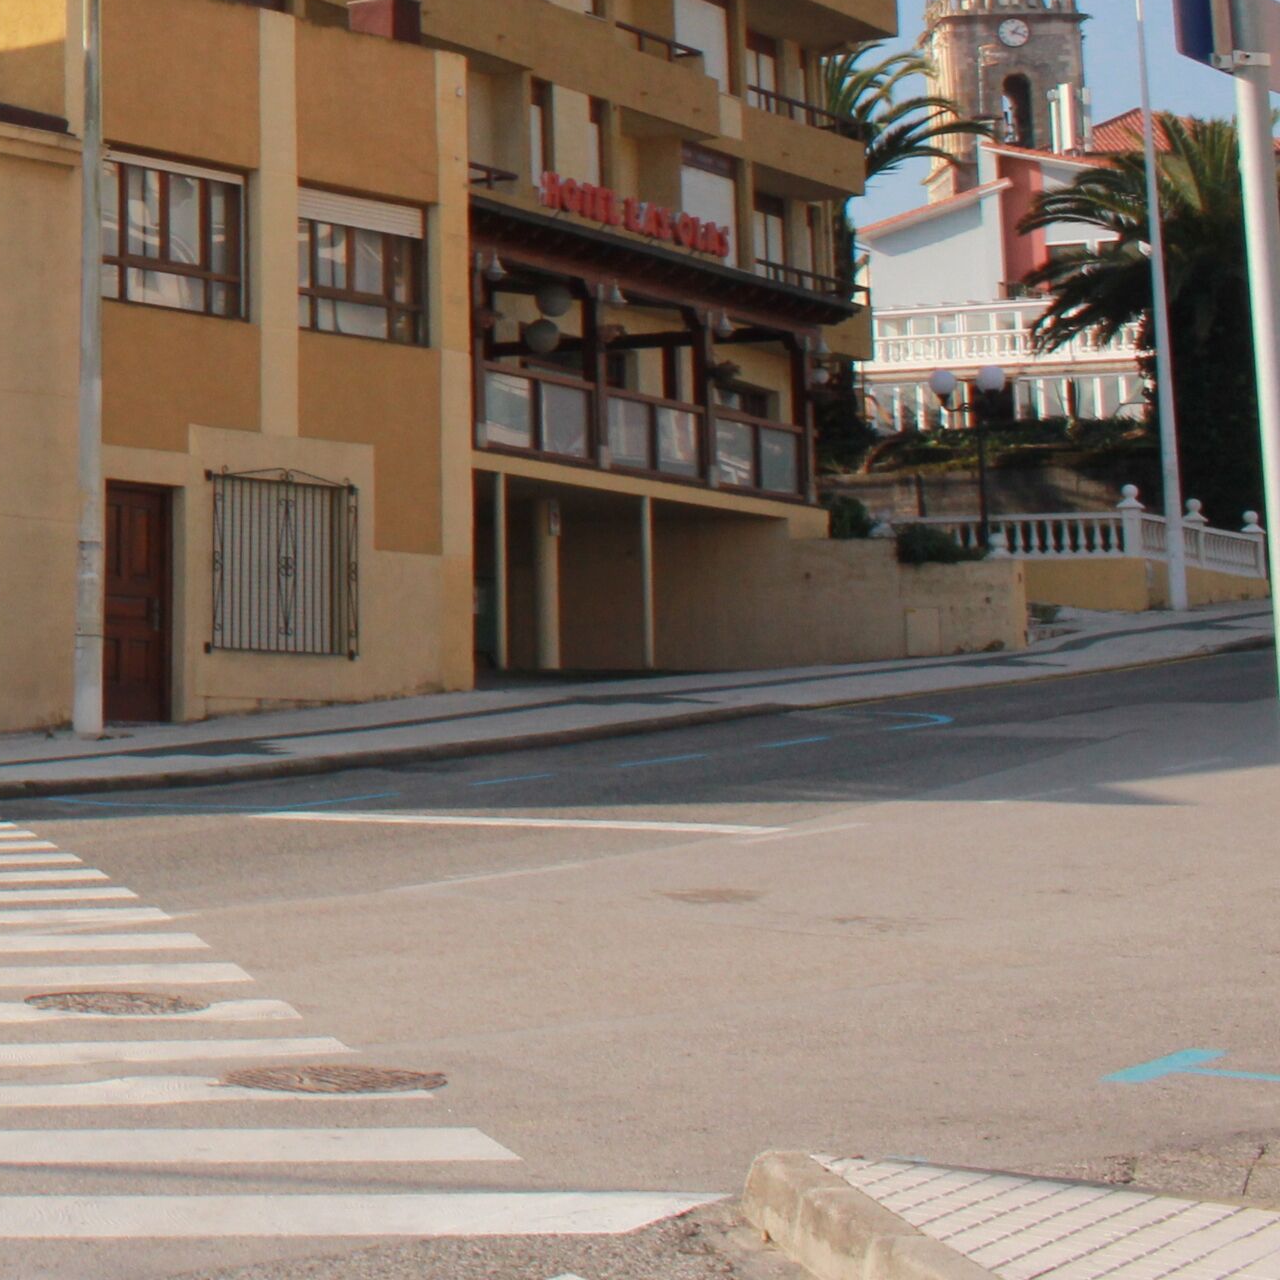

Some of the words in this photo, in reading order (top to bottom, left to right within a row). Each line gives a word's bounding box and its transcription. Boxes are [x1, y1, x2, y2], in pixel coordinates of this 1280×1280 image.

[541, 170, 620, 226] HOTEL
[623, 196, 672, 241] LAS
[673, 211, 730, 258] OLAS
